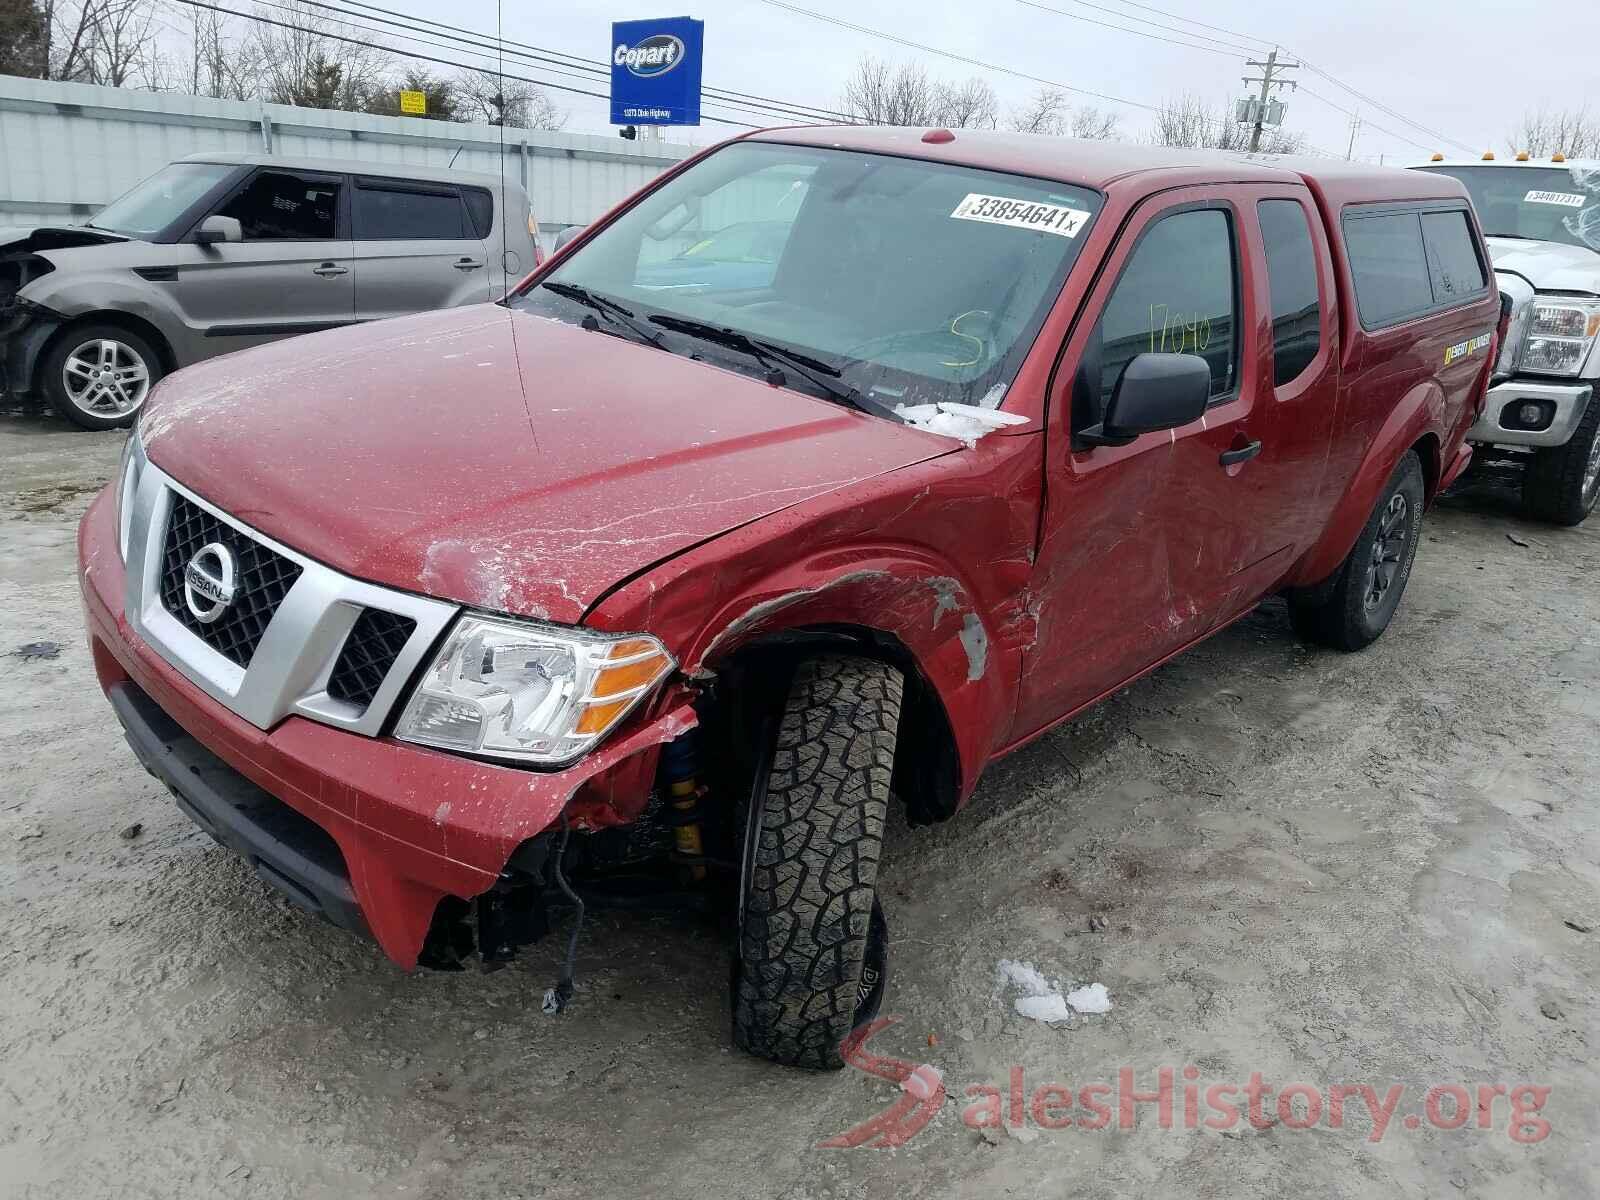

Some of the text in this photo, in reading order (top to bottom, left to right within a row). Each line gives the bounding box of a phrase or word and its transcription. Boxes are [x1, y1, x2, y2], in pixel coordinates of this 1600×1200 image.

[613, 40, 677, 69] Copart
[650, 108, 671, 119] Highway
[186, 563, 223, 598] NISSAN
